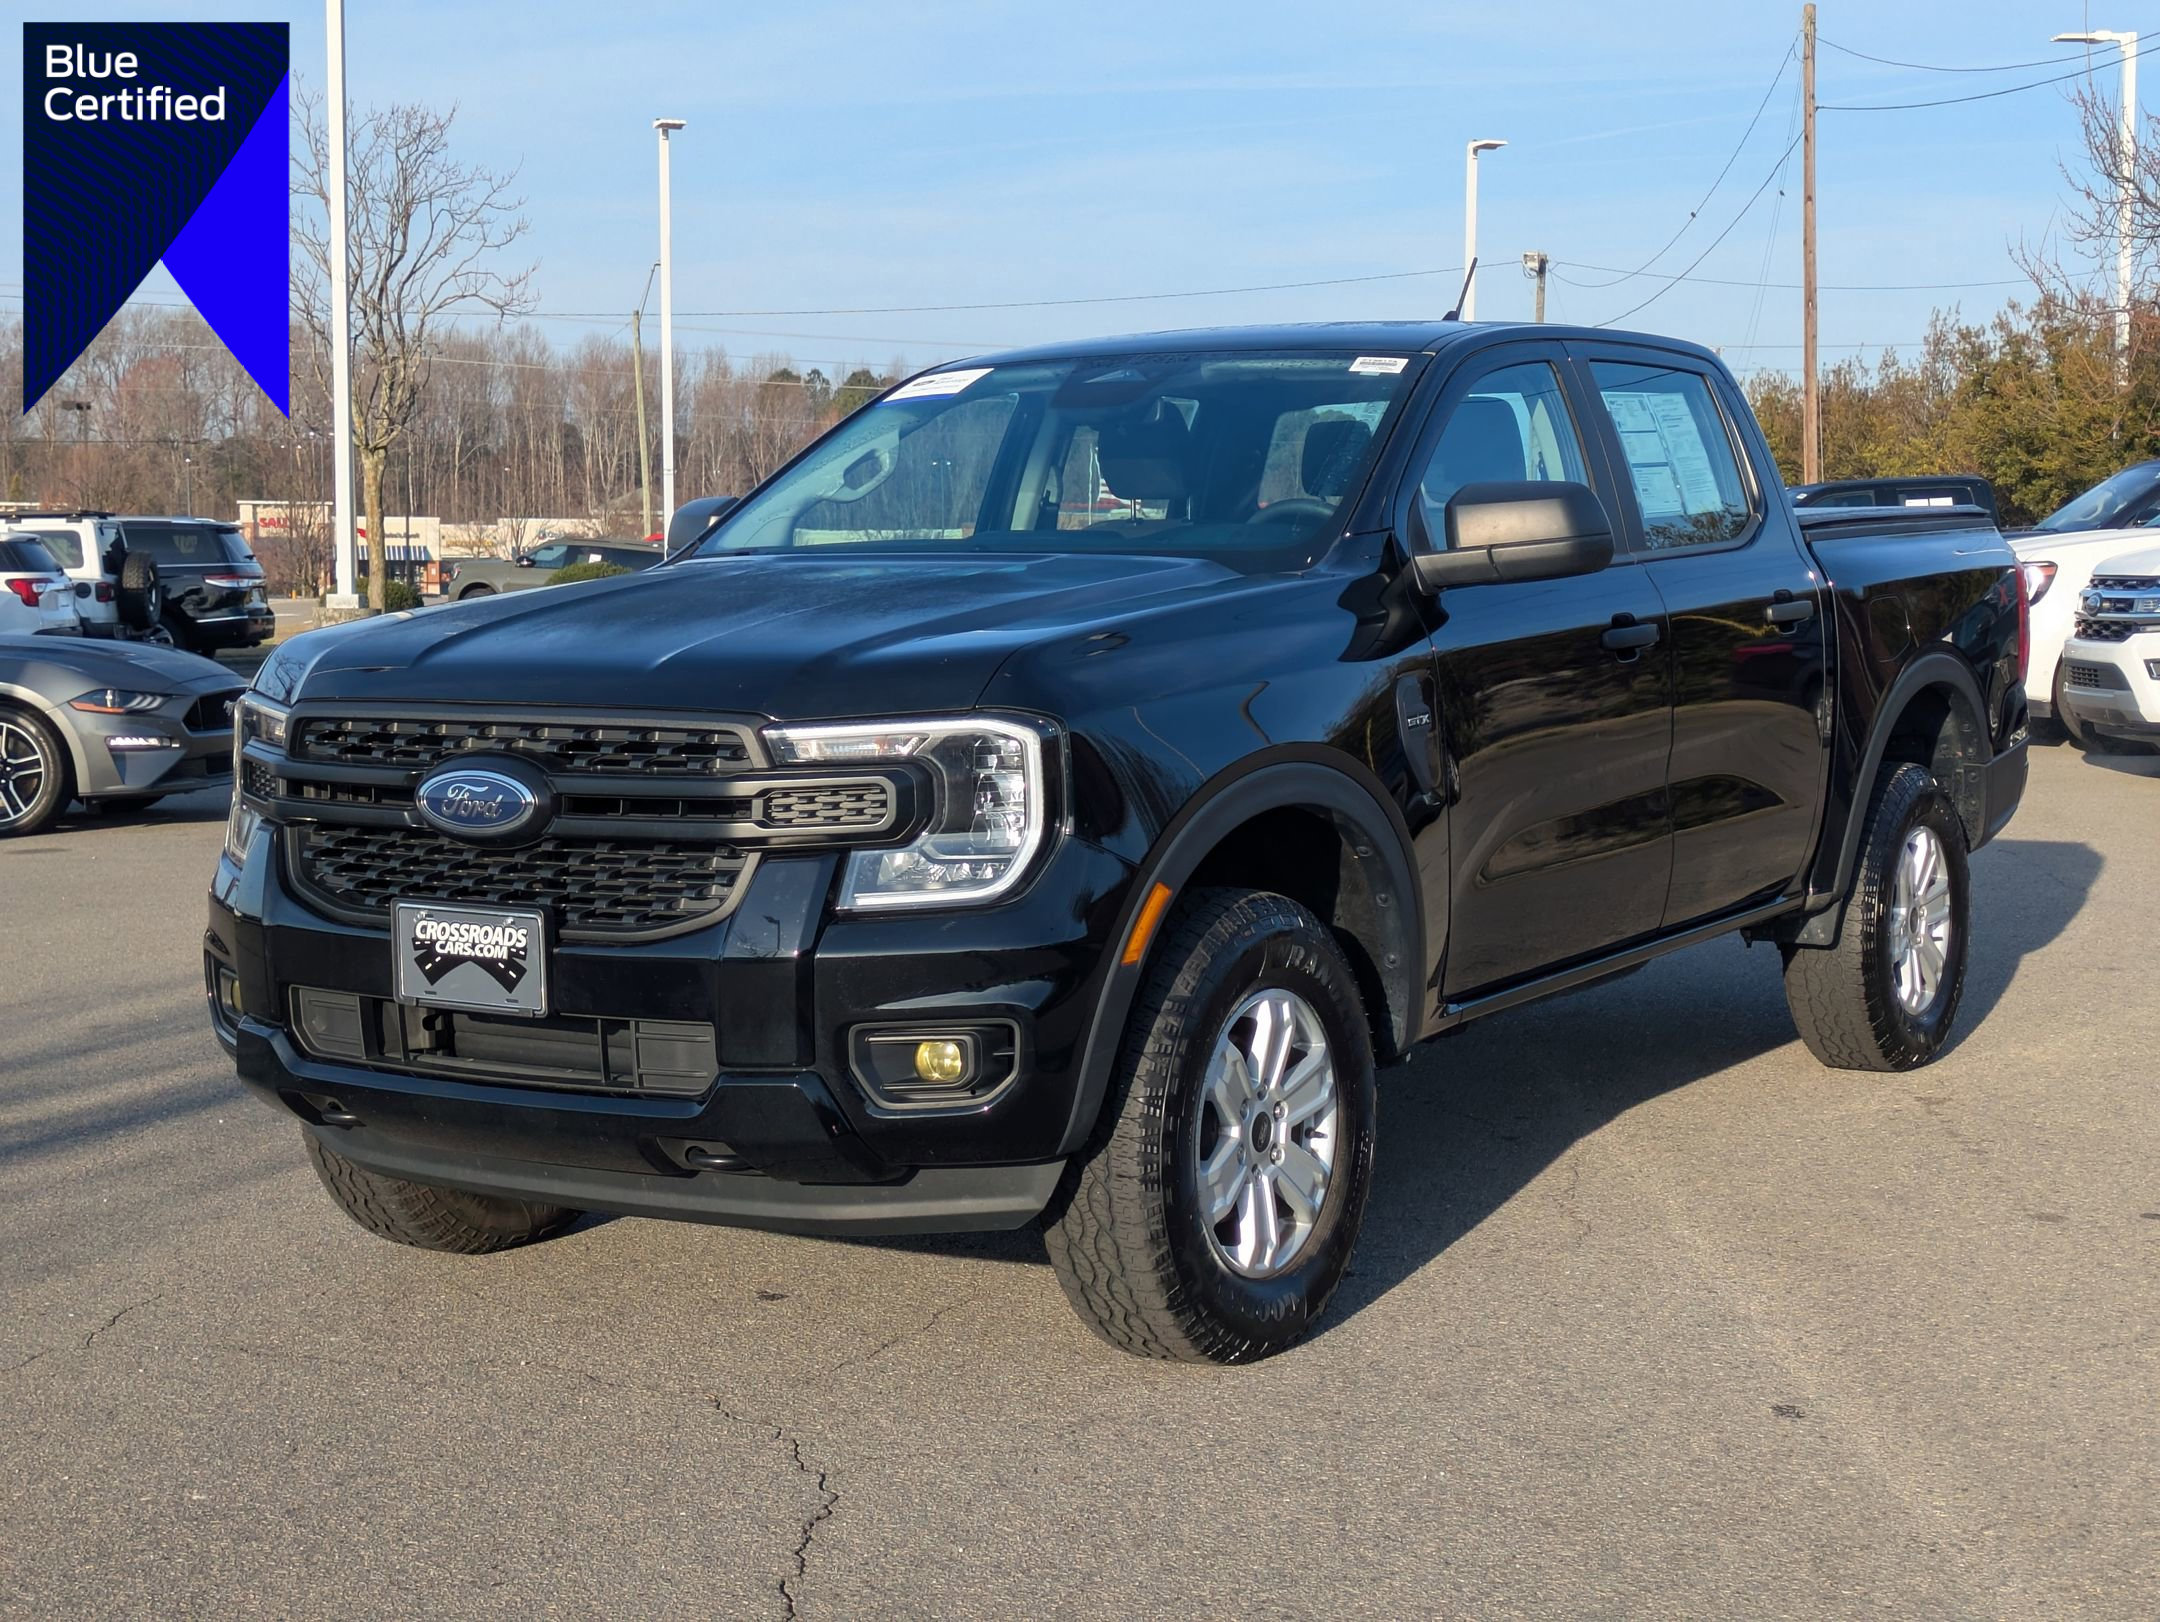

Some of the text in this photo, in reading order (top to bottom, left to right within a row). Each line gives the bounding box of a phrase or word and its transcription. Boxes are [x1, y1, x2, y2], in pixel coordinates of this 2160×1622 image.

[441, 783, 504, 819] Ford
[415, 920, 527, 948] CROSSROADS
[435, 940, 509, 960] CARS.COM
